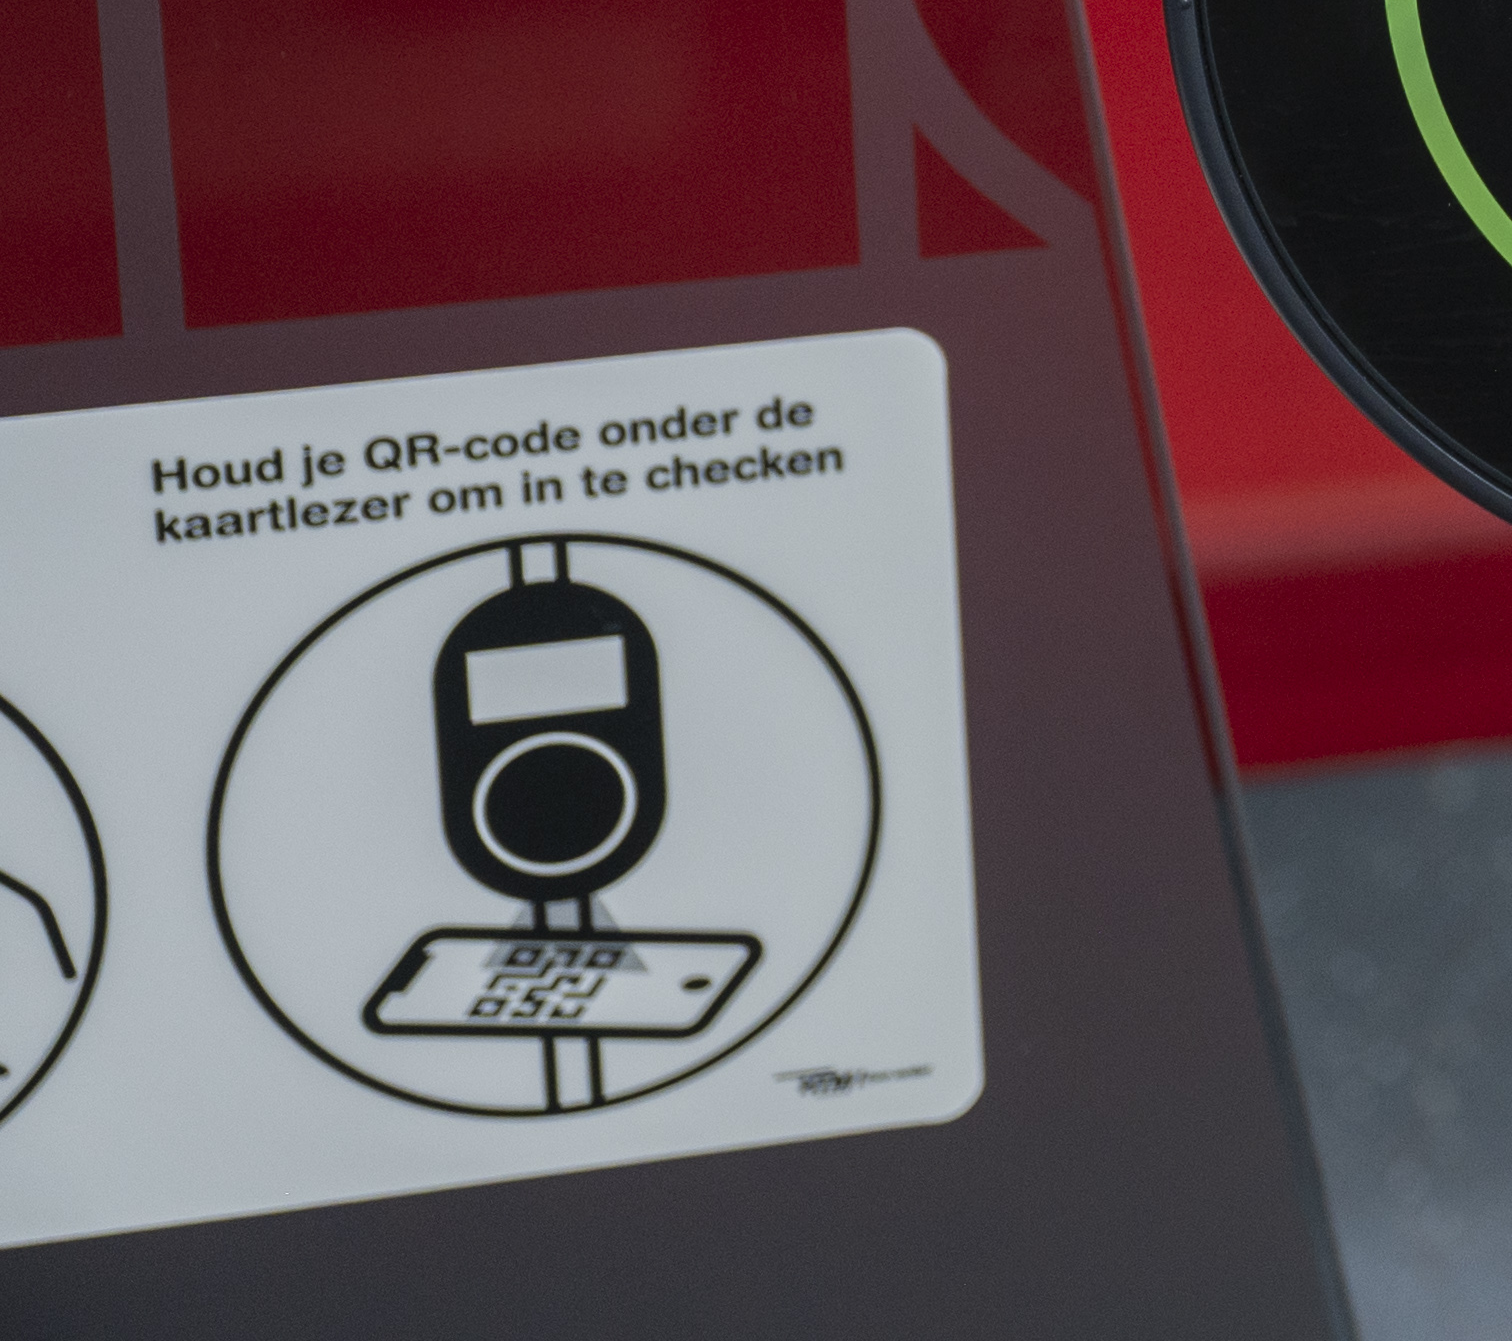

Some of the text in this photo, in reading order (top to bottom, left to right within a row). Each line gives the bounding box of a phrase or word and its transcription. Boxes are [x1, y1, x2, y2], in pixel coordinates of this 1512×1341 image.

[149, 397, 815, 495] Houd je QR-code onder de
[152, 446, 845, 545] kaartlezer om in te checken
